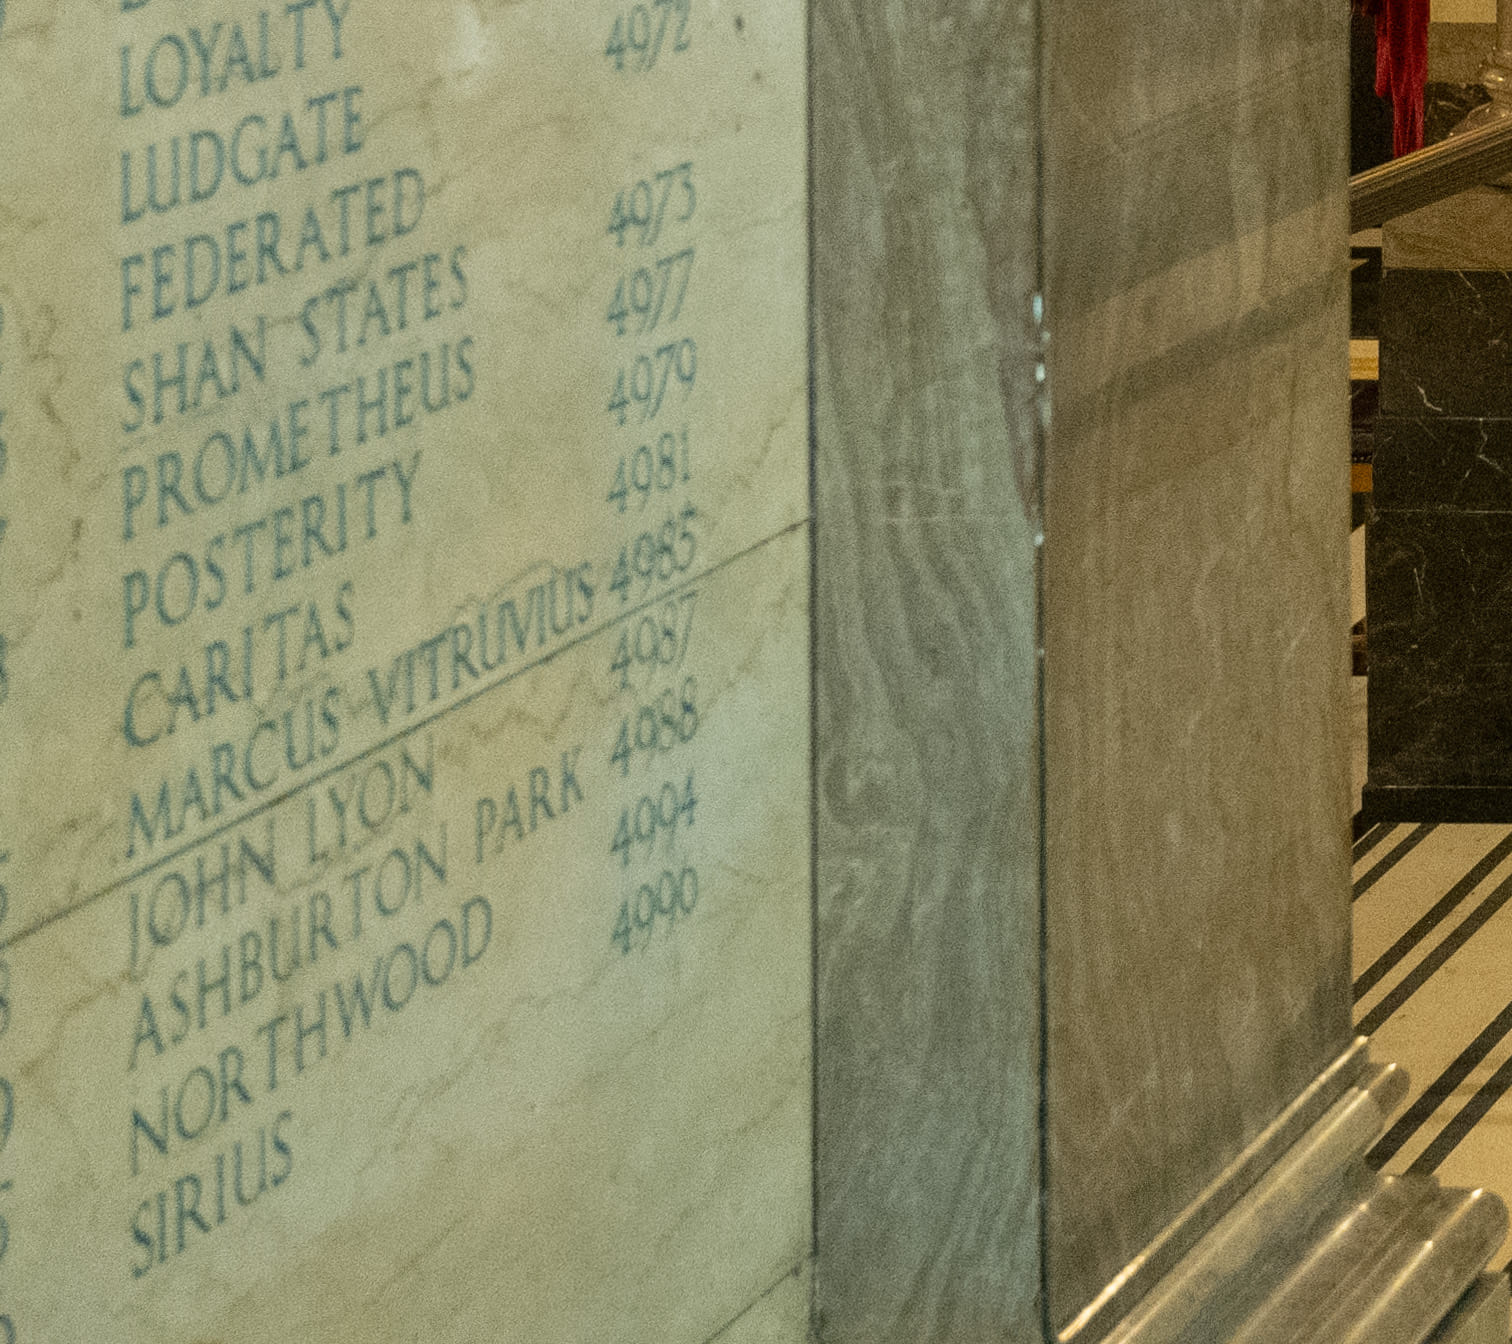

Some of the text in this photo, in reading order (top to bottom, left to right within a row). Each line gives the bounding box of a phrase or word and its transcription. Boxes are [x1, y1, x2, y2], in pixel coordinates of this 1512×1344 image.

[121, 87, 364, 224] LUDGATE
[121, 167, 425, 331] FEDERATED
[123, 162, 696, 433] SHAN STATES 4973
[121, 248, 696, 541] PROMETHEUS 4977
[123, 338, 698, 649] POSTERITY 4979
[123, 422, 692, 750] CARITAS 4981
[125, 500, 697, 859] MARCUS VITRUVIUS 4985
[128, 588, 698, 985] JOHN LYON 4987
[130, 675, 698, 1070] ASHBURTON PARK 4988
[130, 894, 494, 1177] NORTHWOOD
[132, 1108, 295, 1281] SIRIUS
